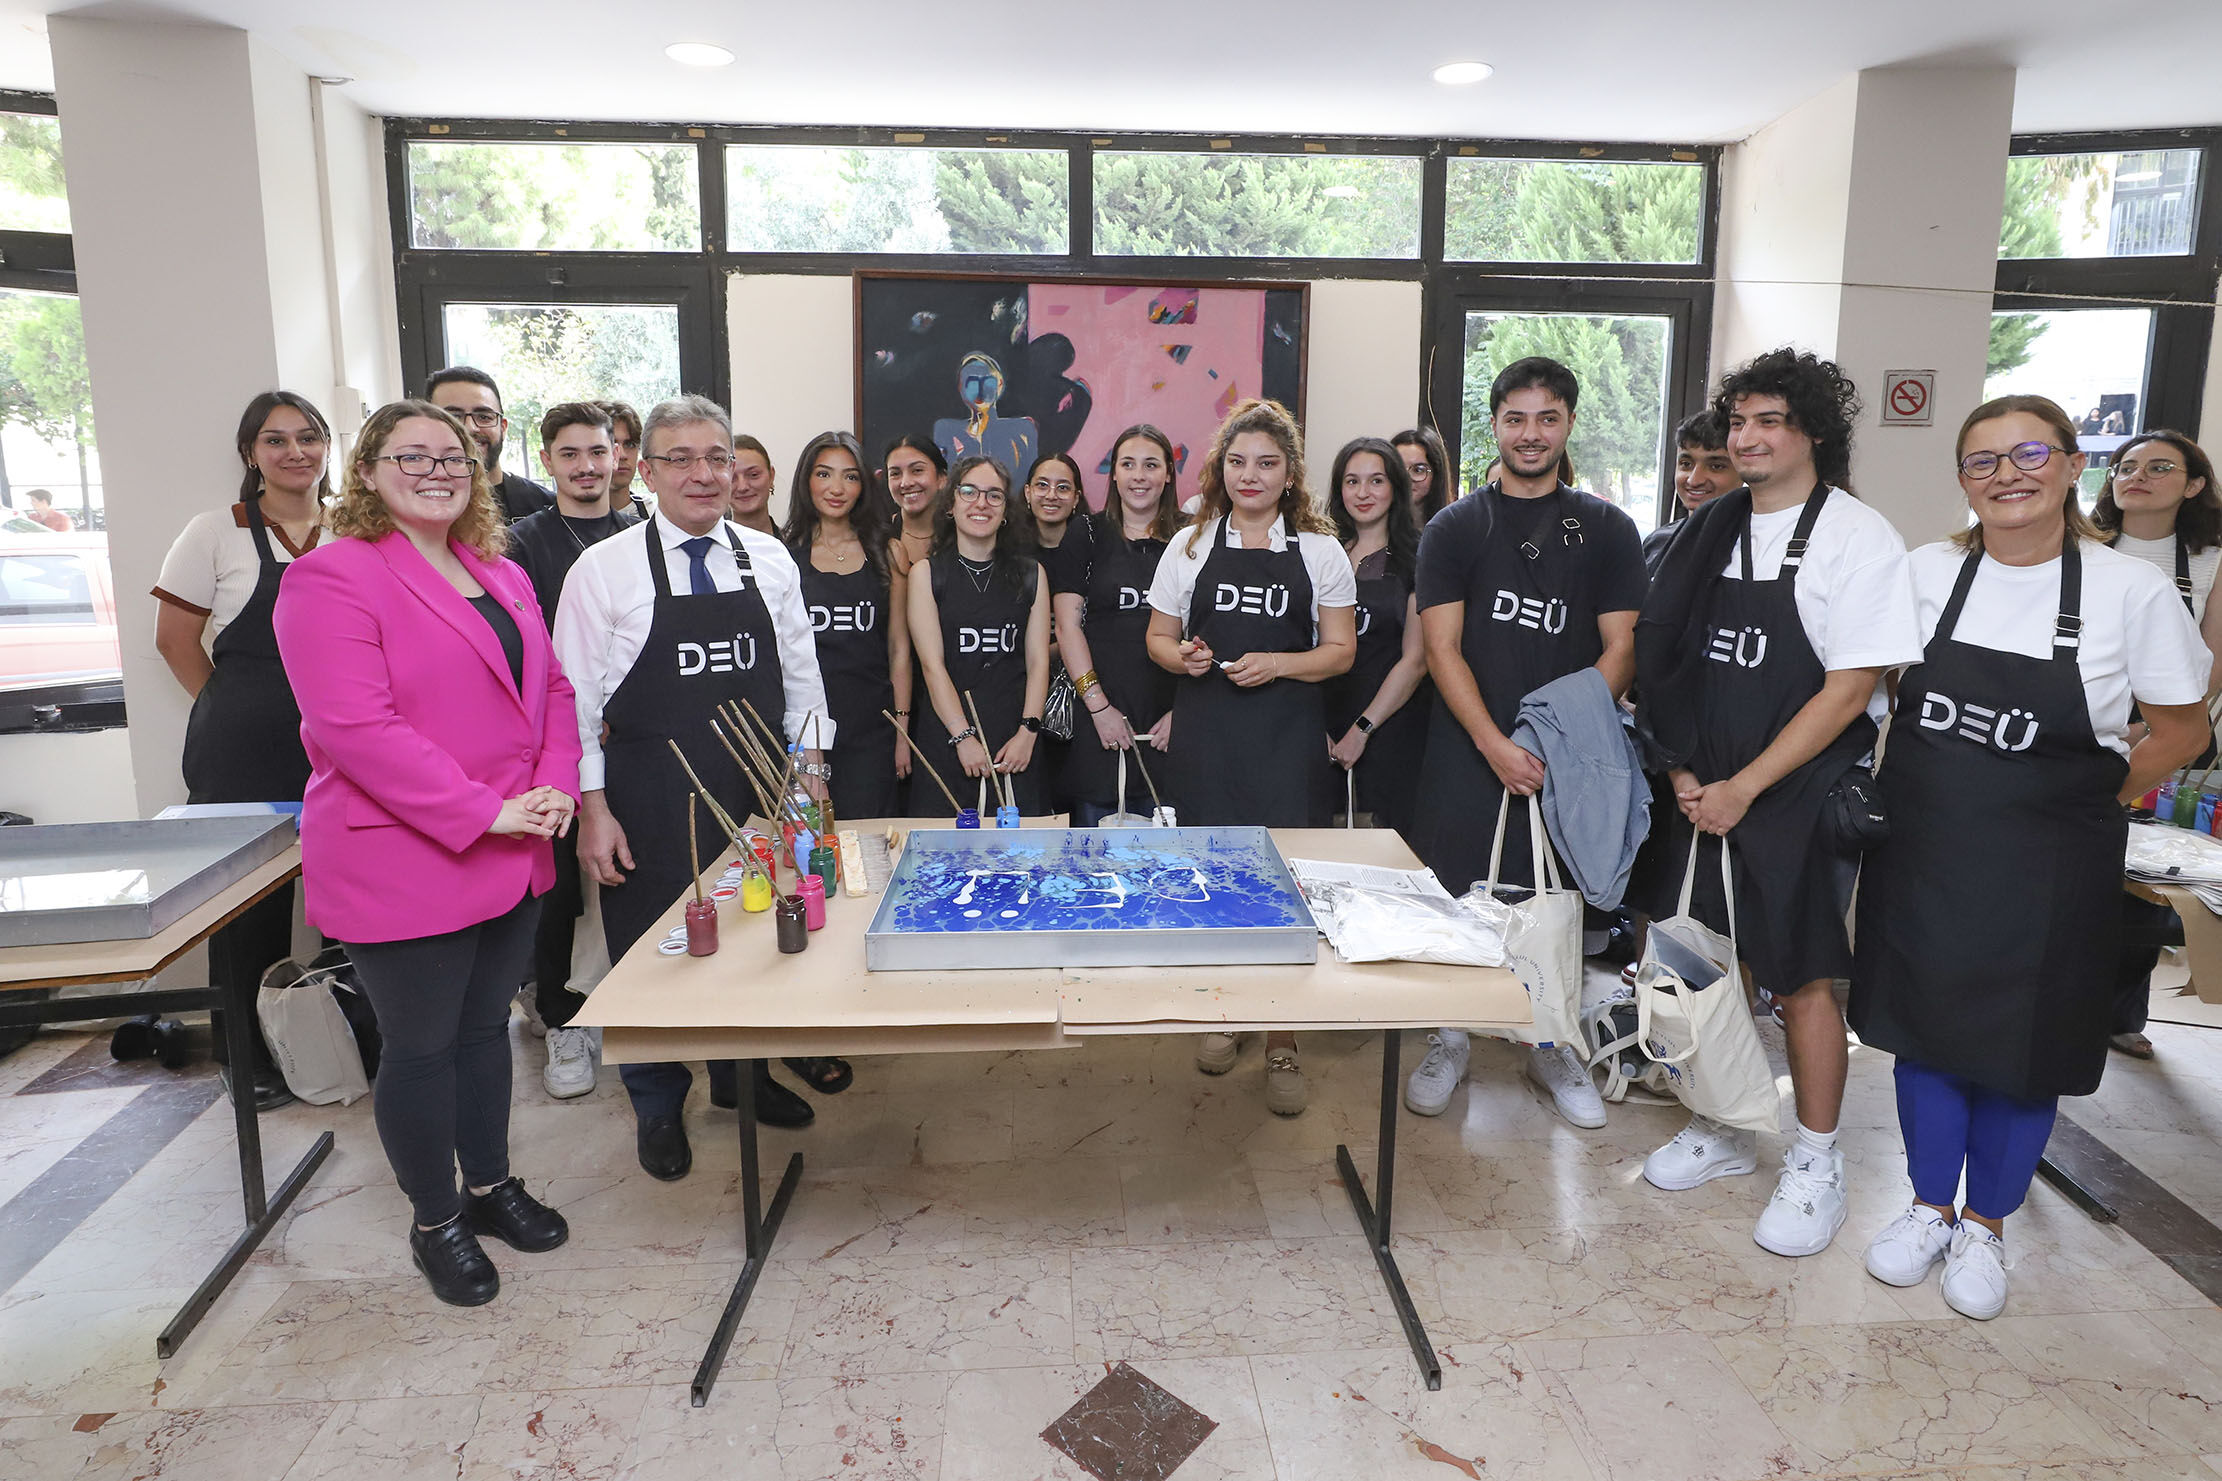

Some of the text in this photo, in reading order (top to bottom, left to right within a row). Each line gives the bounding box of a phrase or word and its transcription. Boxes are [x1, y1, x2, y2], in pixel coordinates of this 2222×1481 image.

[808, 600, 875, 632] DEÜ
[1119, 585, 1152, 611] DE
[1215, 583, 1290, 618] DEÜ
[1491, 589, 1568, 635] DEÜ
[677, 632, 756, 676] DEÜ
[959, 623, 1018, 653] DEÜ
[1705, 625, 1768, 669] EÜ
[1919, 691, 2040, 752] DEÜ
